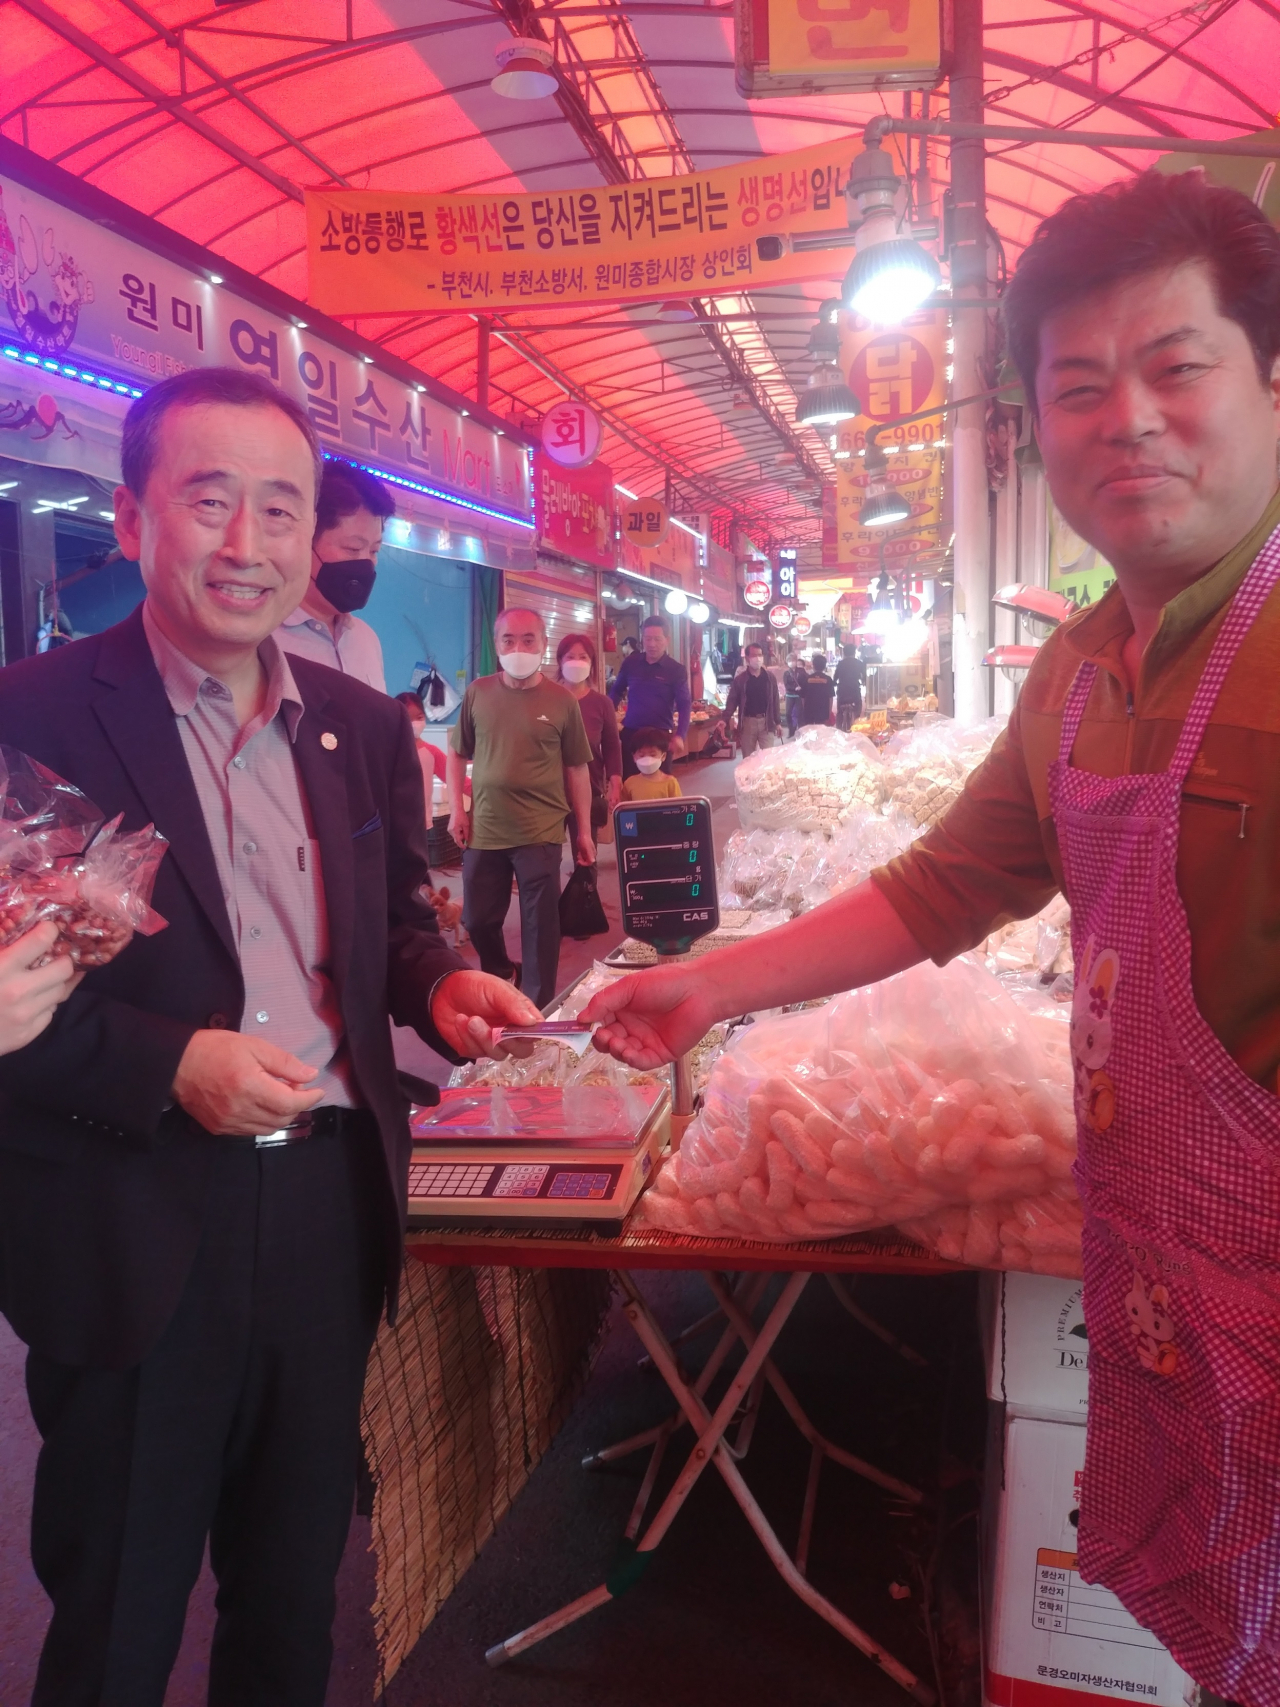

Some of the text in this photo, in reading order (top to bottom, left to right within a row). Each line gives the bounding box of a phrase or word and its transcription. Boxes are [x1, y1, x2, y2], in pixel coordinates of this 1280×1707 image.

[320, 166, 856, 255] 소방통행로 황색선은 당신을 지켜드리는 생명선입니
[594, 254, 696, 292] 원미종합시장
[701, 243, 752, 280] 상인회
[118, 273, 205, 352] 원미
[865, 340, 918, 417] 닭
[551, 408, 587, 457] 회
[442, 428, 491, 497] Mart
[628, 511, 661, 533] 과일
[686, 813, 694, 826] 0
[689, 849, 698, 863] 0
[691, 884, 700, 897] 0
[683, 911, 709, 921] CAS
[1040, 1569, 1066, 1582] 생산지
[1039, 1584, 1065, 1597] 생산자
[1038, 1600, 1063, 1613] 연락처
[1036, 1665, 1158, 1696] 문경오미자생산자협의회
